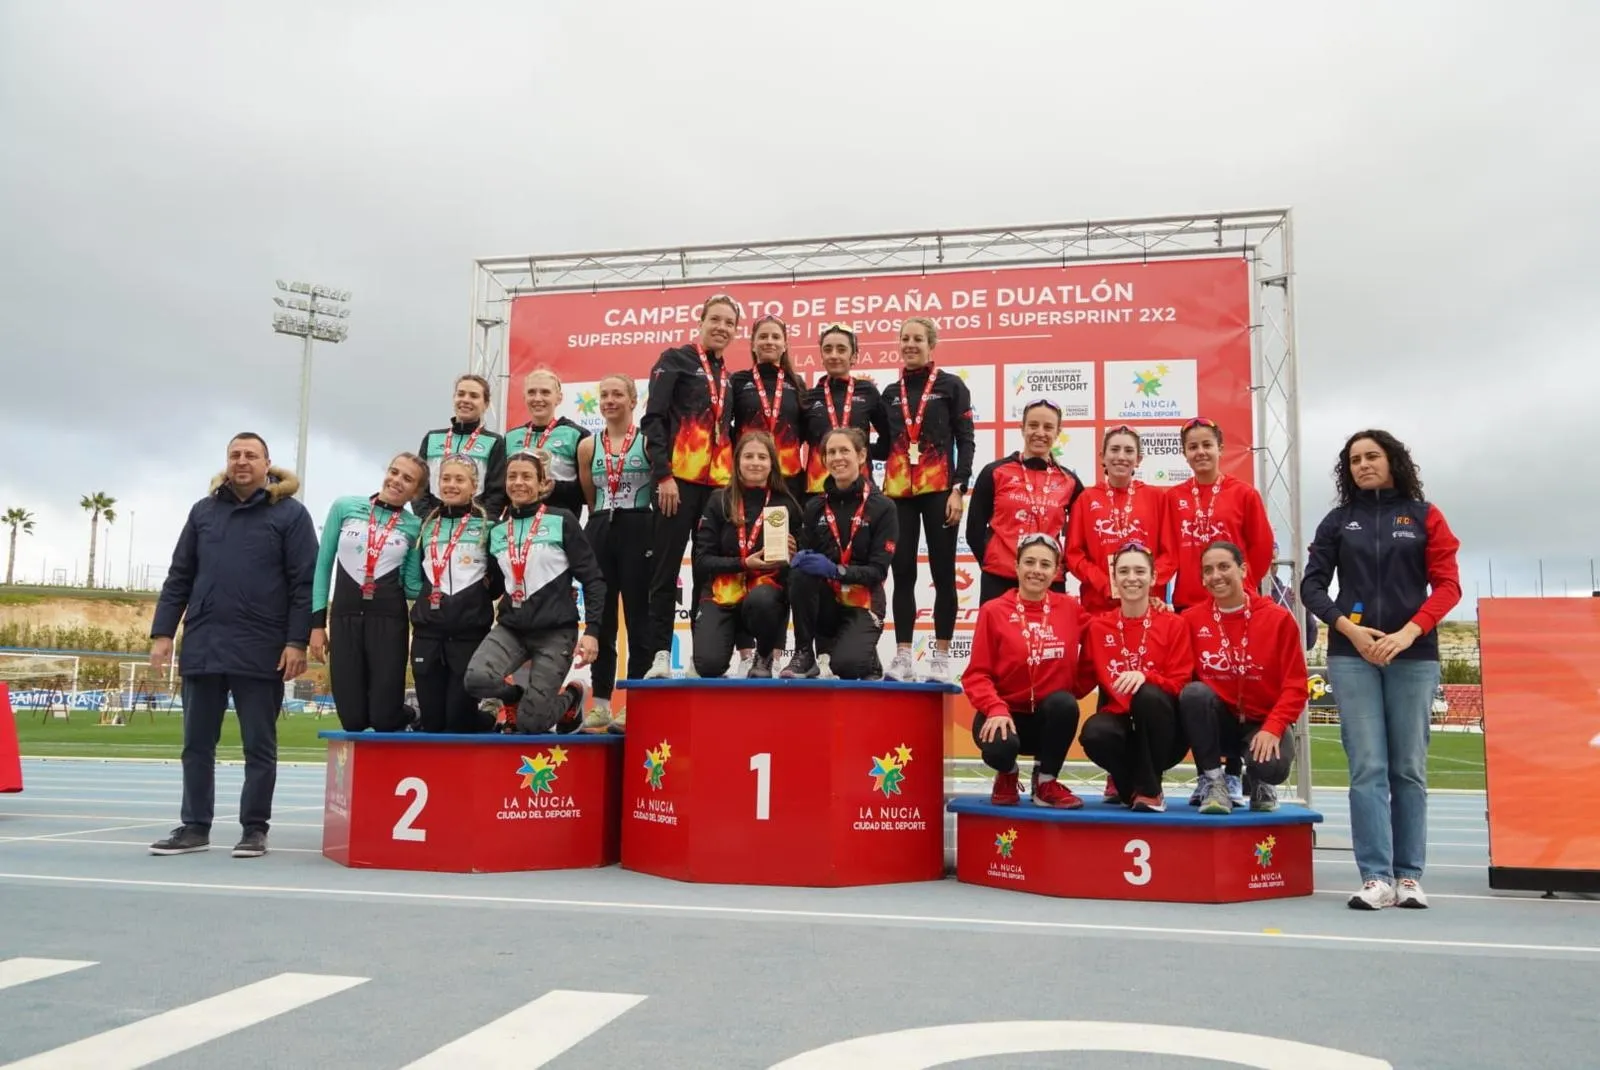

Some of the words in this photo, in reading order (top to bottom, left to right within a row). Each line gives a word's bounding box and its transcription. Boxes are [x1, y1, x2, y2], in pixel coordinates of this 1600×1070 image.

[792, 298, 826, 317] DE
[835, 289, 942, 315] ESPAÑA
[952, 289, 988, 309] DE
[997, 278, 1133, 307] DUATLÓN
[999, 308, 1133, 327] SUPERSPRINT
[1139, 307, 1177, 322] 2X2
[568, 329, 684, 348] SUPERSPRINT
[795, 354, 815, 367] LA
[1027, 374, 1081, 383] COMUNITAT
[1046, 382, 1088, 391] L'ESPORT
[1124, 400, 1136, 408] LA
[750, 752, 771, 821] 1
[392, 776, 429, 842] 2
[504, 797, 519, 809] LA
[636, 797, 646, 809] LA
[496, 811, 528, 820] CIUDAD
[528, 810, 544, 819] DEL
[545, 809, 581, 818] DEPORTE
[859, 807, 873, 819] LA
[853, 821, 880, 830] CIUDAD
[881, 821, 893, 830] DEL
[895, 821, 926, 830] DEPORTE
[990, 862, 998, 870] LA
[1123, 838, 1152, 885] 3
[1251, 874, 1258, 882] LA
